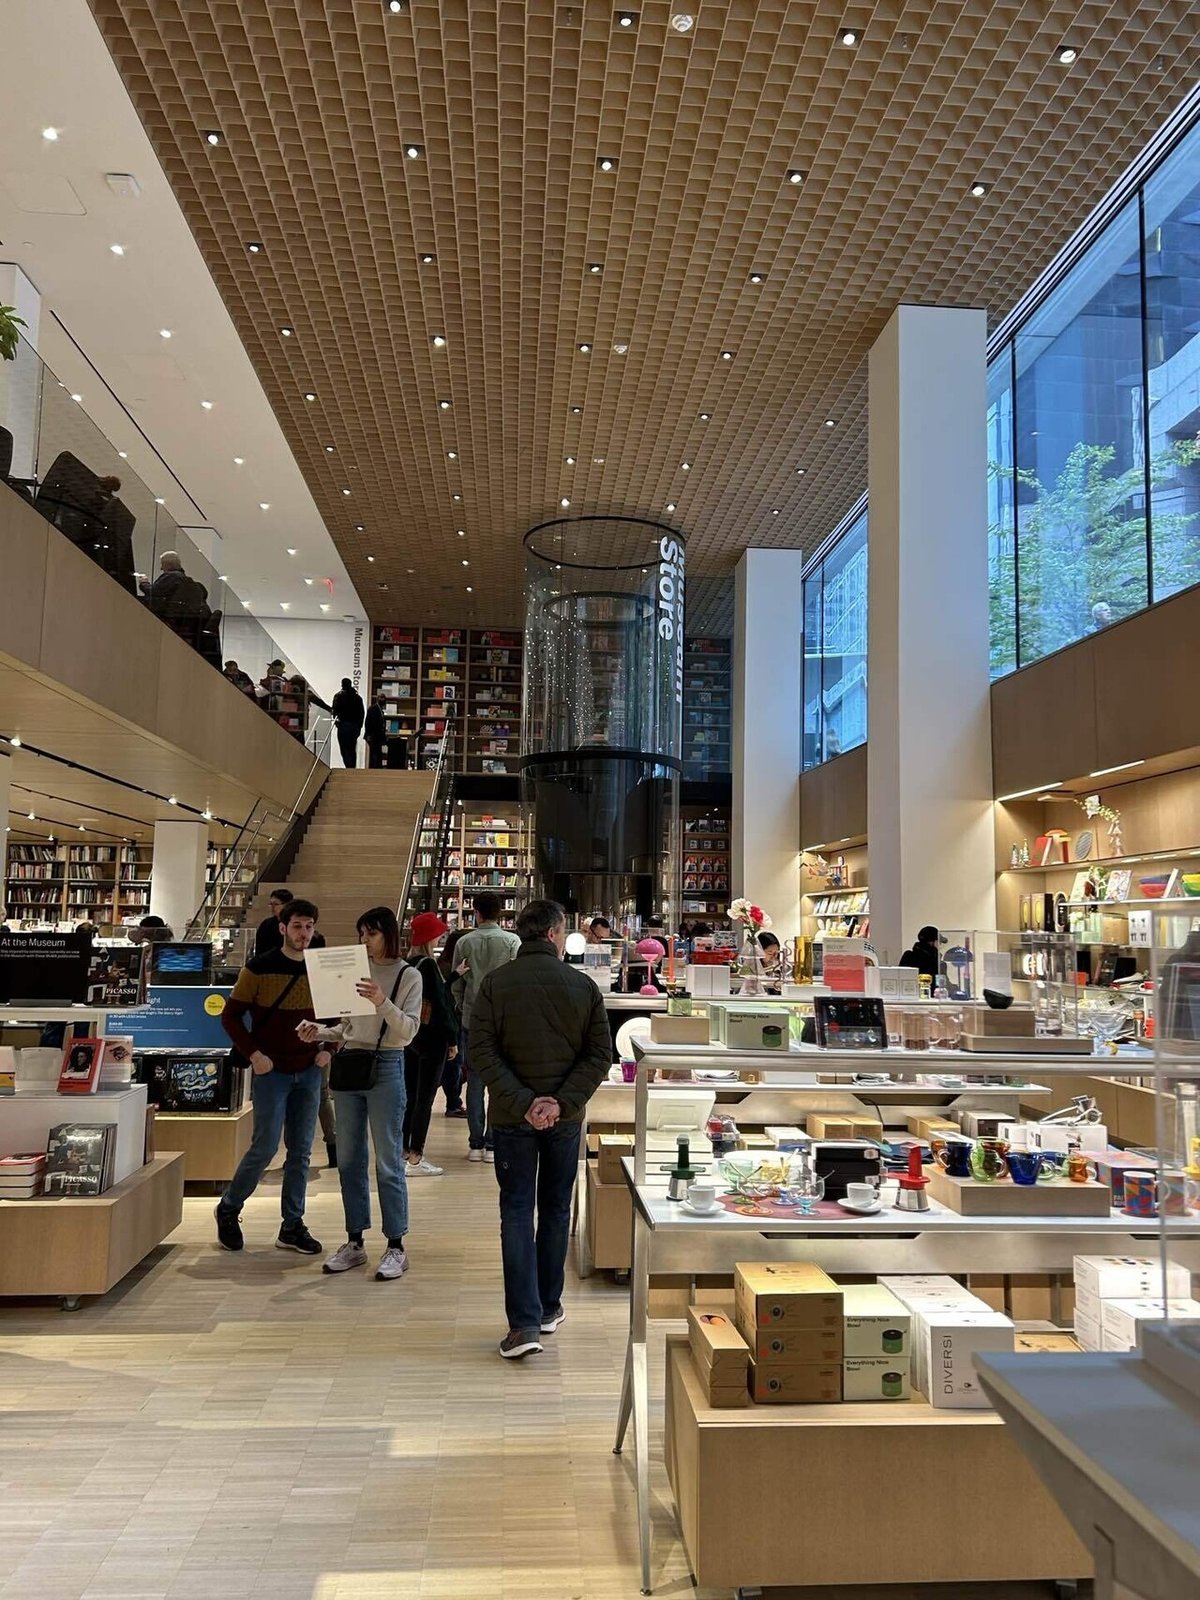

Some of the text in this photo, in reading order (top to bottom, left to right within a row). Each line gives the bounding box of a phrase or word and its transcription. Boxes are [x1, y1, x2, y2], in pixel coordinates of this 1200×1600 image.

[659, 536, 679, 641] Store
[353, 627, 363, 694] Museum Stor
[1, 938, 66, 947] At the Museum
[942, 1335, 953, 1394] DIVERSI
